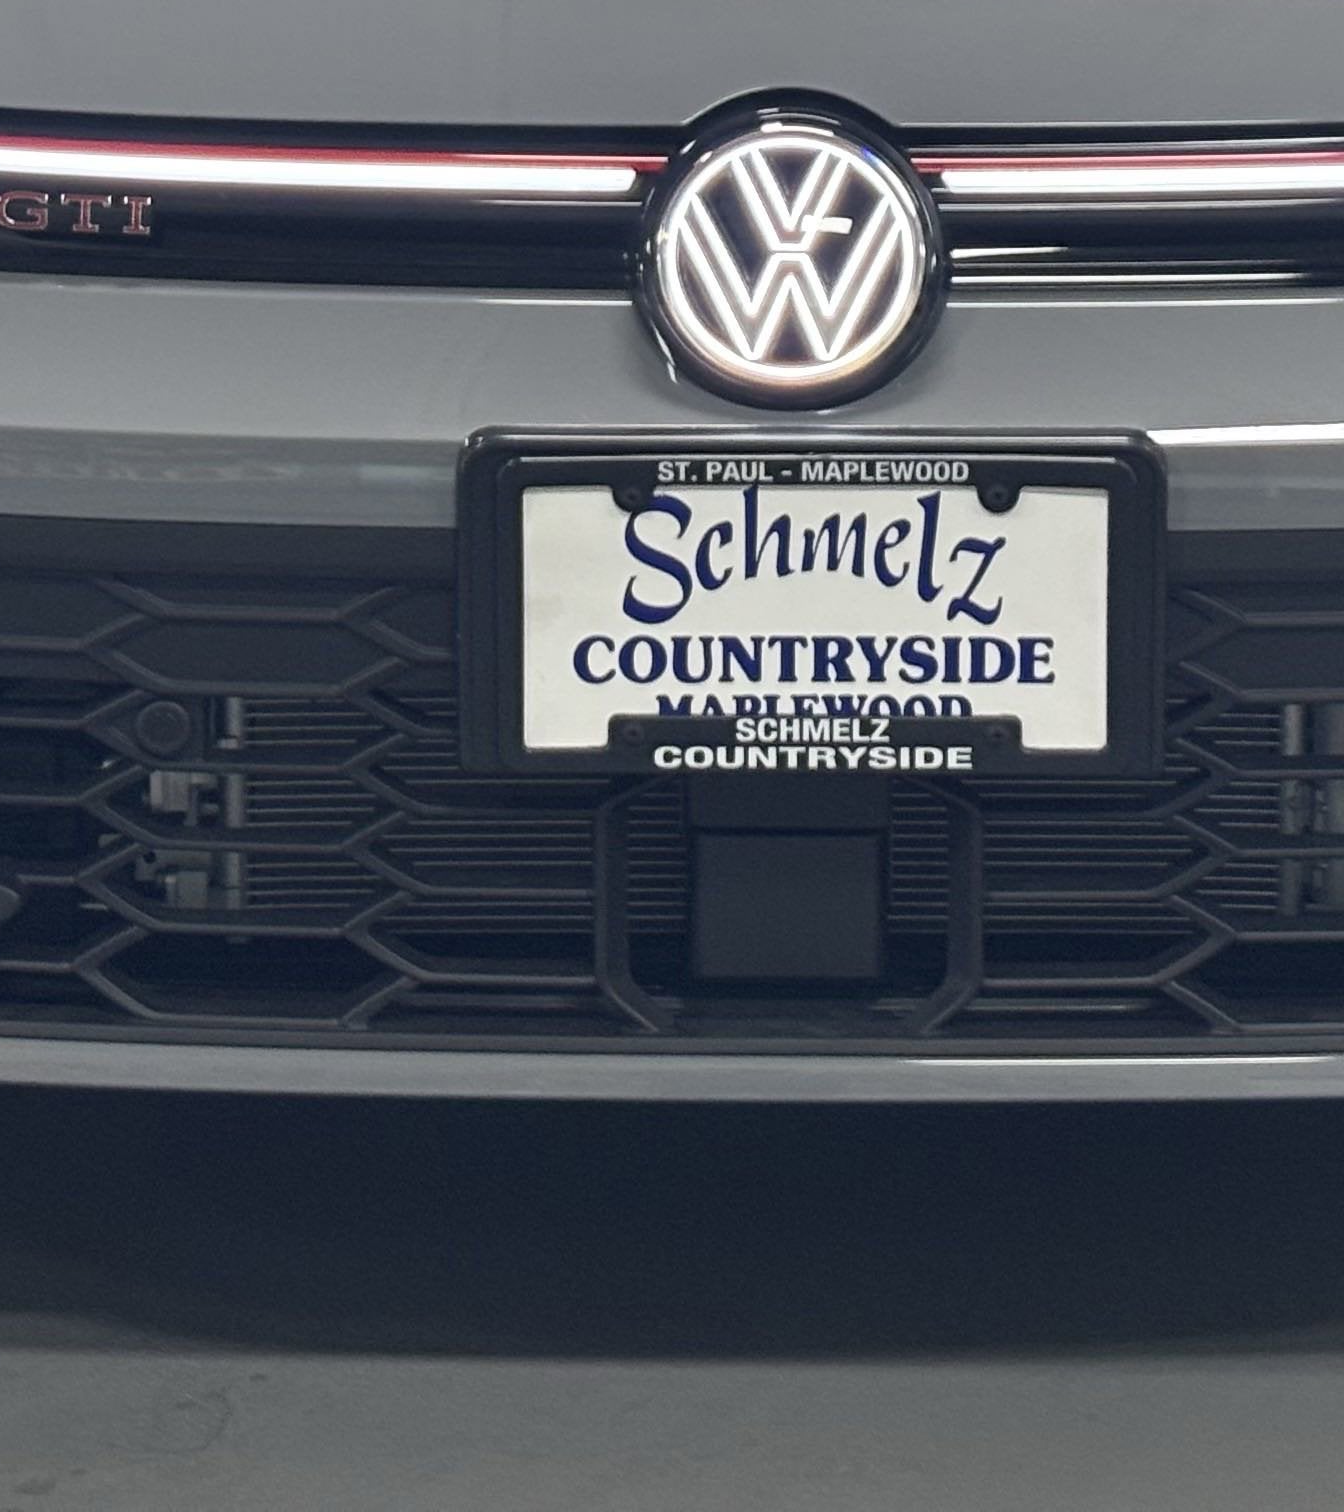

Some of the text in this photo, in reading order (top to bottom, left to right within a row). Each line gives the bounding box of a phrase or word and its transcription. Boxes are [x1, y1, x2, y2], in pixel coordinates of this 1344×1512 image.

[657, 461, 697, 482] ST.
[706, 461, 774, 482] PAUL
[801, 461, 970, 482] MAPLEWOOD
[623, 485, 1007, 626] Schmelz
[572, 634, 1056, 685] COUNTRYSIDE
[735, 717, 891, 743] SCHMELZ
[653, 746, 974, 770] COUNTRYSIDE
